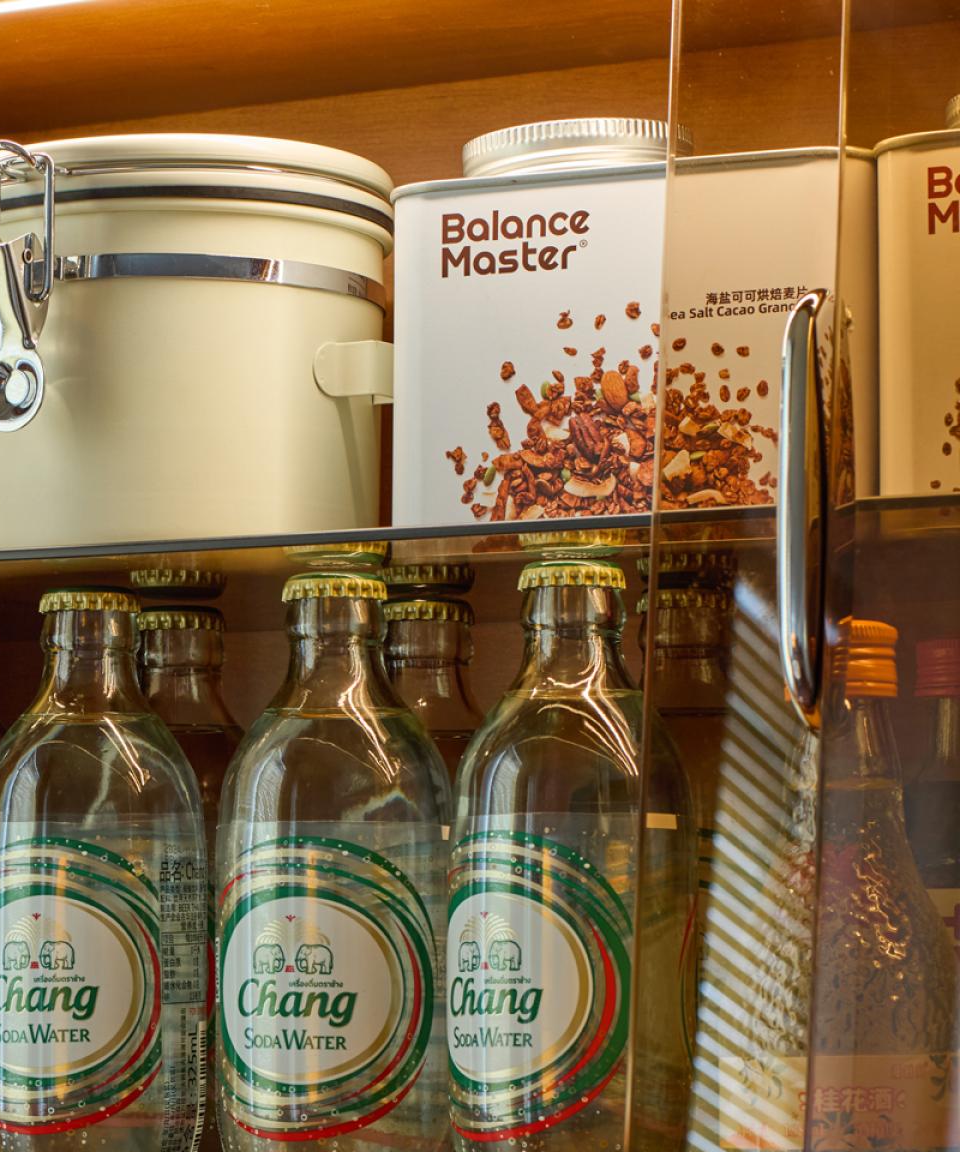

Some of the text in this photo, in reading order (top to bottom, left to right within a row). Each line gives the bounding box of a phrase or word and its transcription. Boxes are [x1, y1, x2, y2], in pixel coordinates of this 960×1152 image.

[442, 210, 590, 245] Balance
[690, 307, 714, 319] Salt
[717, 303, 756, 317] Cacao
[237, 978, 358, 1028] Chang
[450, 976, 544, 1025] Chang
